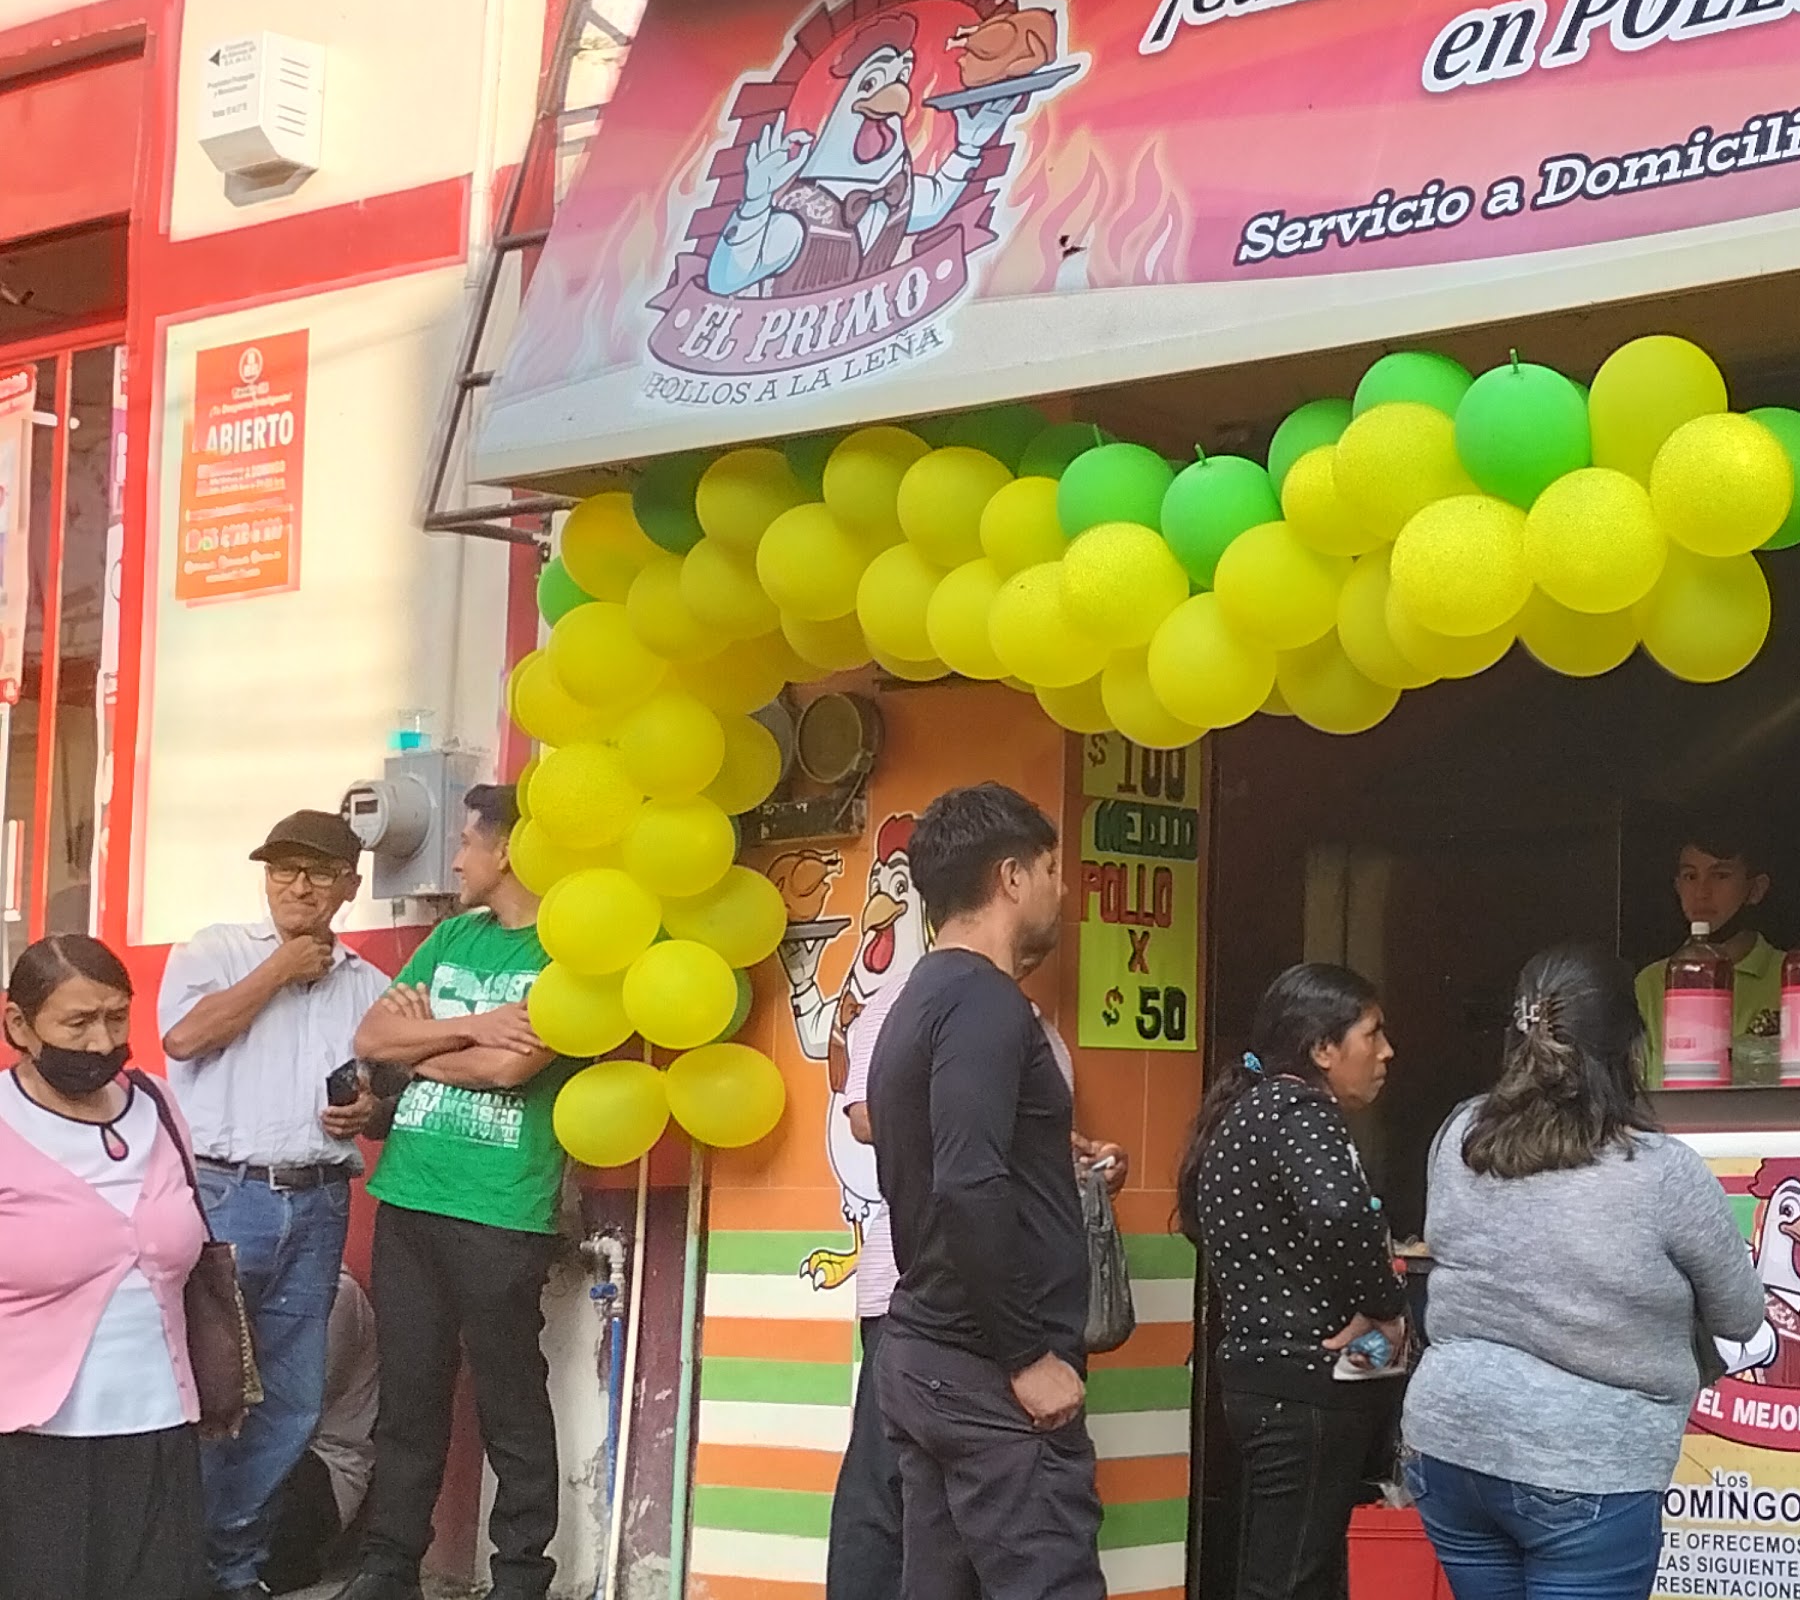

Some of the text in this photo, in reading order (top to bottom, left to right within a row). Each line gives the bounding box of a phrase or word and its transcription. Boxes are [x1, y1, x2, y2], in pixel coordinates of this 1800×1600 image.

[1431, 6, 1537, 83] en
[1239, 184, 1470, 262] Servicio
[1485, 179, 1520, 215] a
[678, 266, 931, 363] EL PRIMO
[646, 324, 944, 405] POLLOS A LA LEÑA
[206, 410, 294, 457] ABIERTO
[1088, 732, 1186, 802] $ 100
[1081, 860, 1173, 928] POLLO
[1128, 929, 1150, 974] X
[1102, 986, 1187, 1041] $ 50
[1697, 1388, 1724, 1419] EL
[1715, 1470, 1748, 1488] Los
